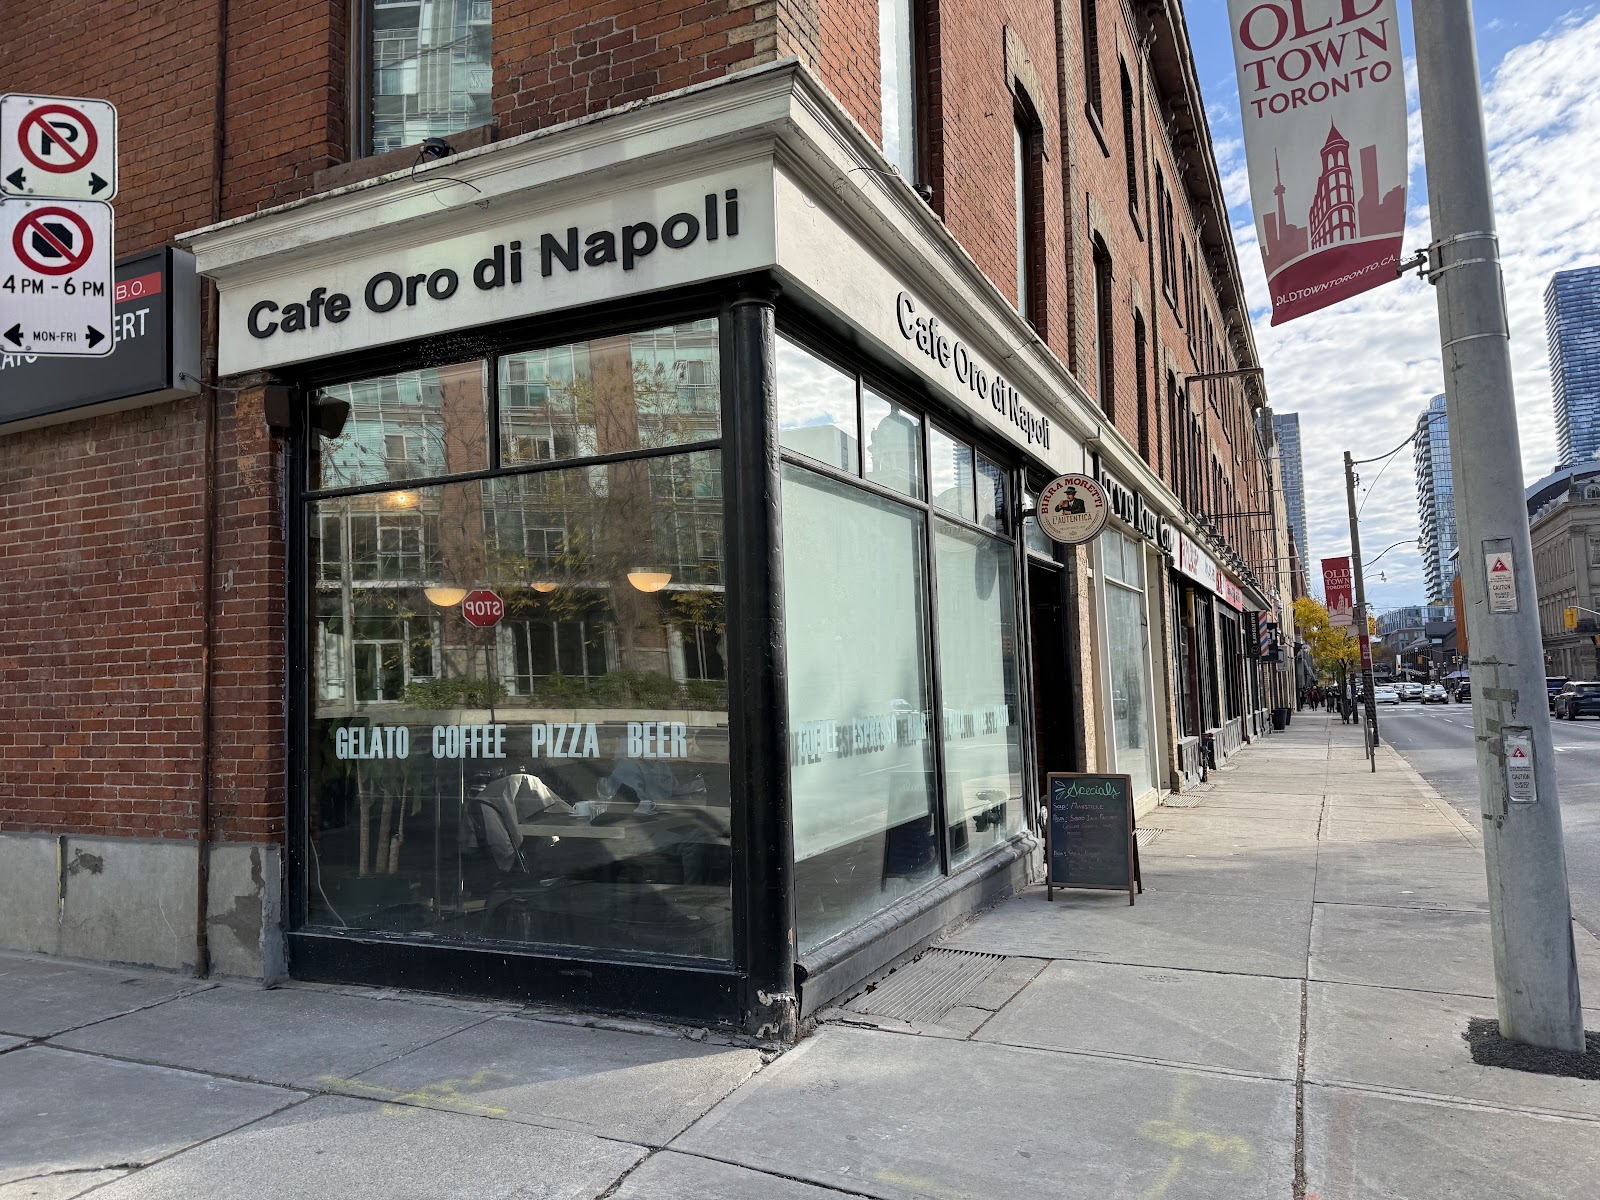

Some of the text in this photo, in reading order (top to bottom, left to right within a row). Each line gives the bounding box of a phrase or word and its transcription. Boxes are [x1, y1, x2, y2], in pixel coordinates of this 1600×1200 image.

[1243, 18, 1390, 91] TOWN
[1250, 60, 1392, 118] TORONTO
[247, 188, 739, 339] Cafe Oro di Napoli
[2, 275, 16, 294] 4
[21, 279, 44, 294] PM
[64, 277, 76, 295] 6
[82, 281, 105, 297] PM
[33, 331, 77, 342] MON-FRI
[896, 291, 1051, 450] Cafe Oro di Napoli
[1041, 478, 1103, 514] BIRRA MORETTI
[1052, 513, 1093, 525] L'AUTENTICA
[1324, 568, 1350, 579] OLD
[1325, 577, 1350, 586] TOWN
[335, 721, 688, 760] GELATO COFFEE PIZZA BEER
